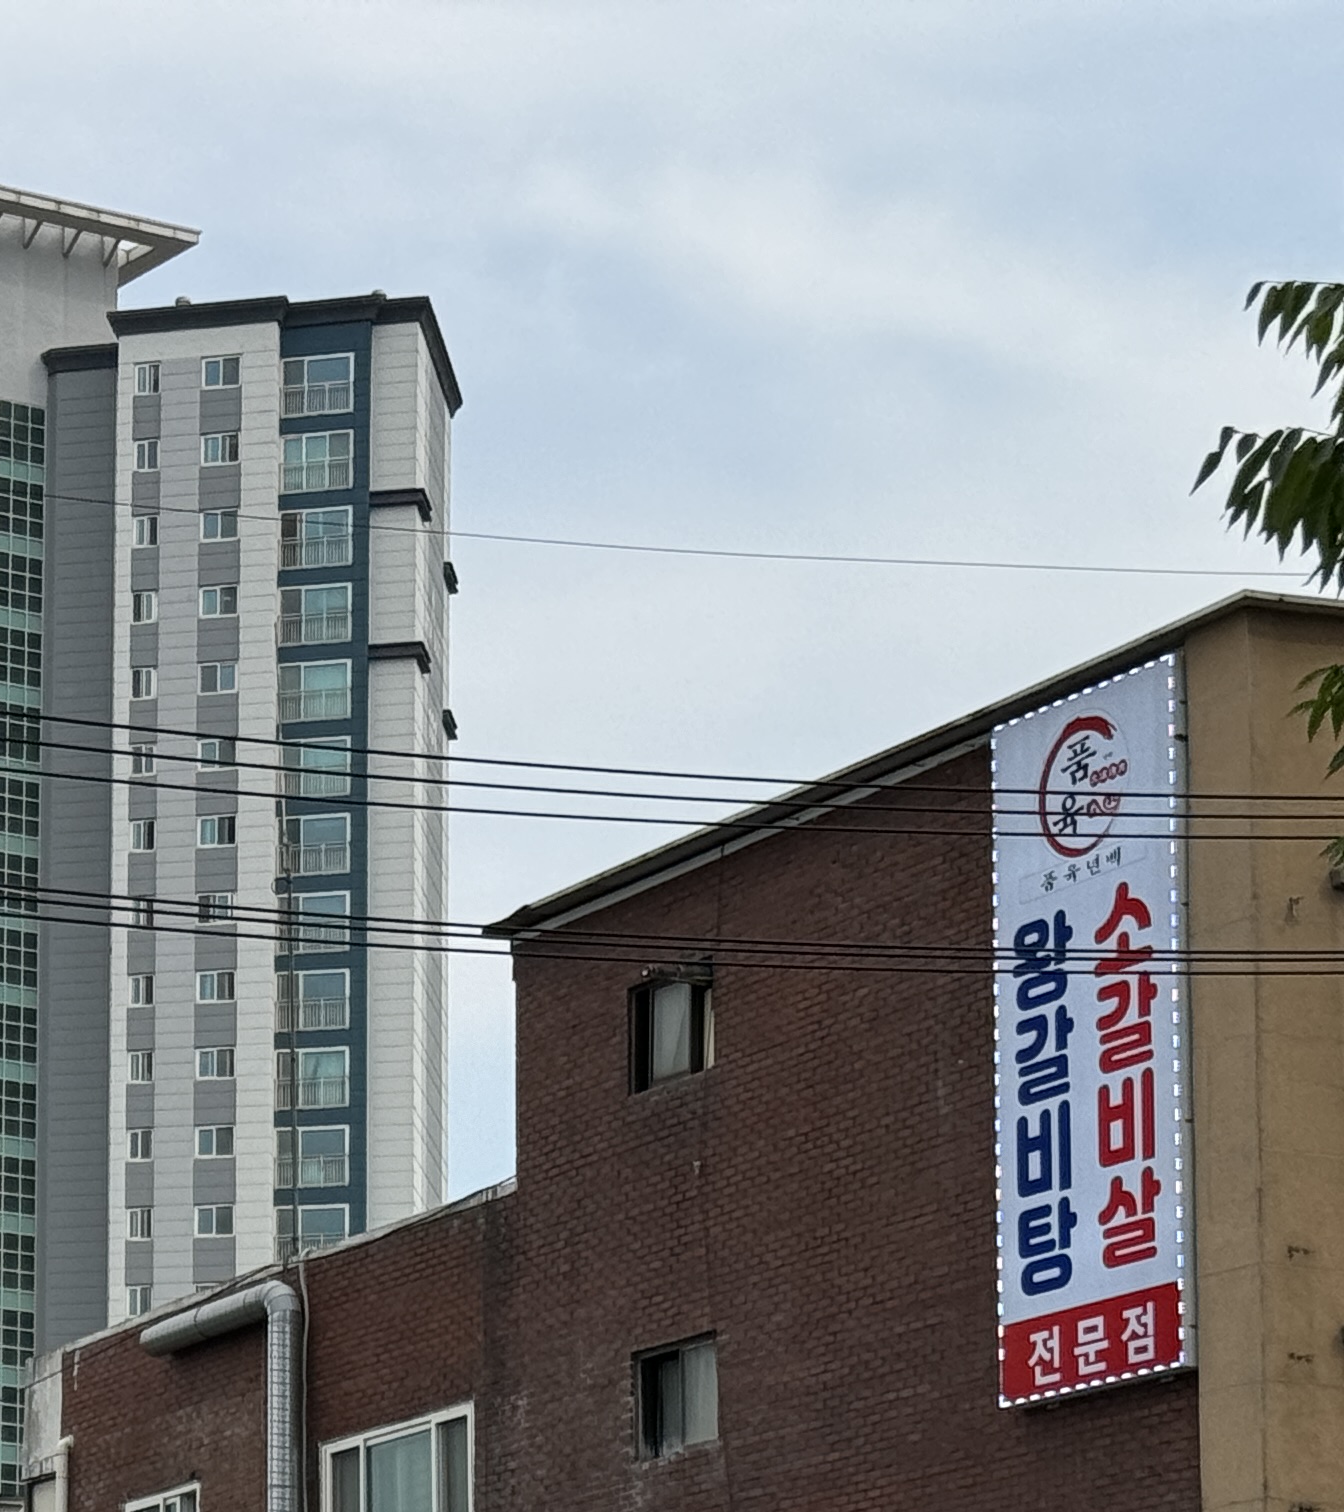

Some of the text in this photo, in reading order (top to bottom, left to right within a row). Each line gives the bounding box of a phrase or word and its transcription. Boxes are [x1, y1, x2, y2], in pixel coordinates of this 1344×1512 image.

[1012, 910, 1076, 1297] 왕갈비탕
[1093, 882, 1161, 1270] 소갈비살
[1026, 1302, 1156, 1387] 전문점
